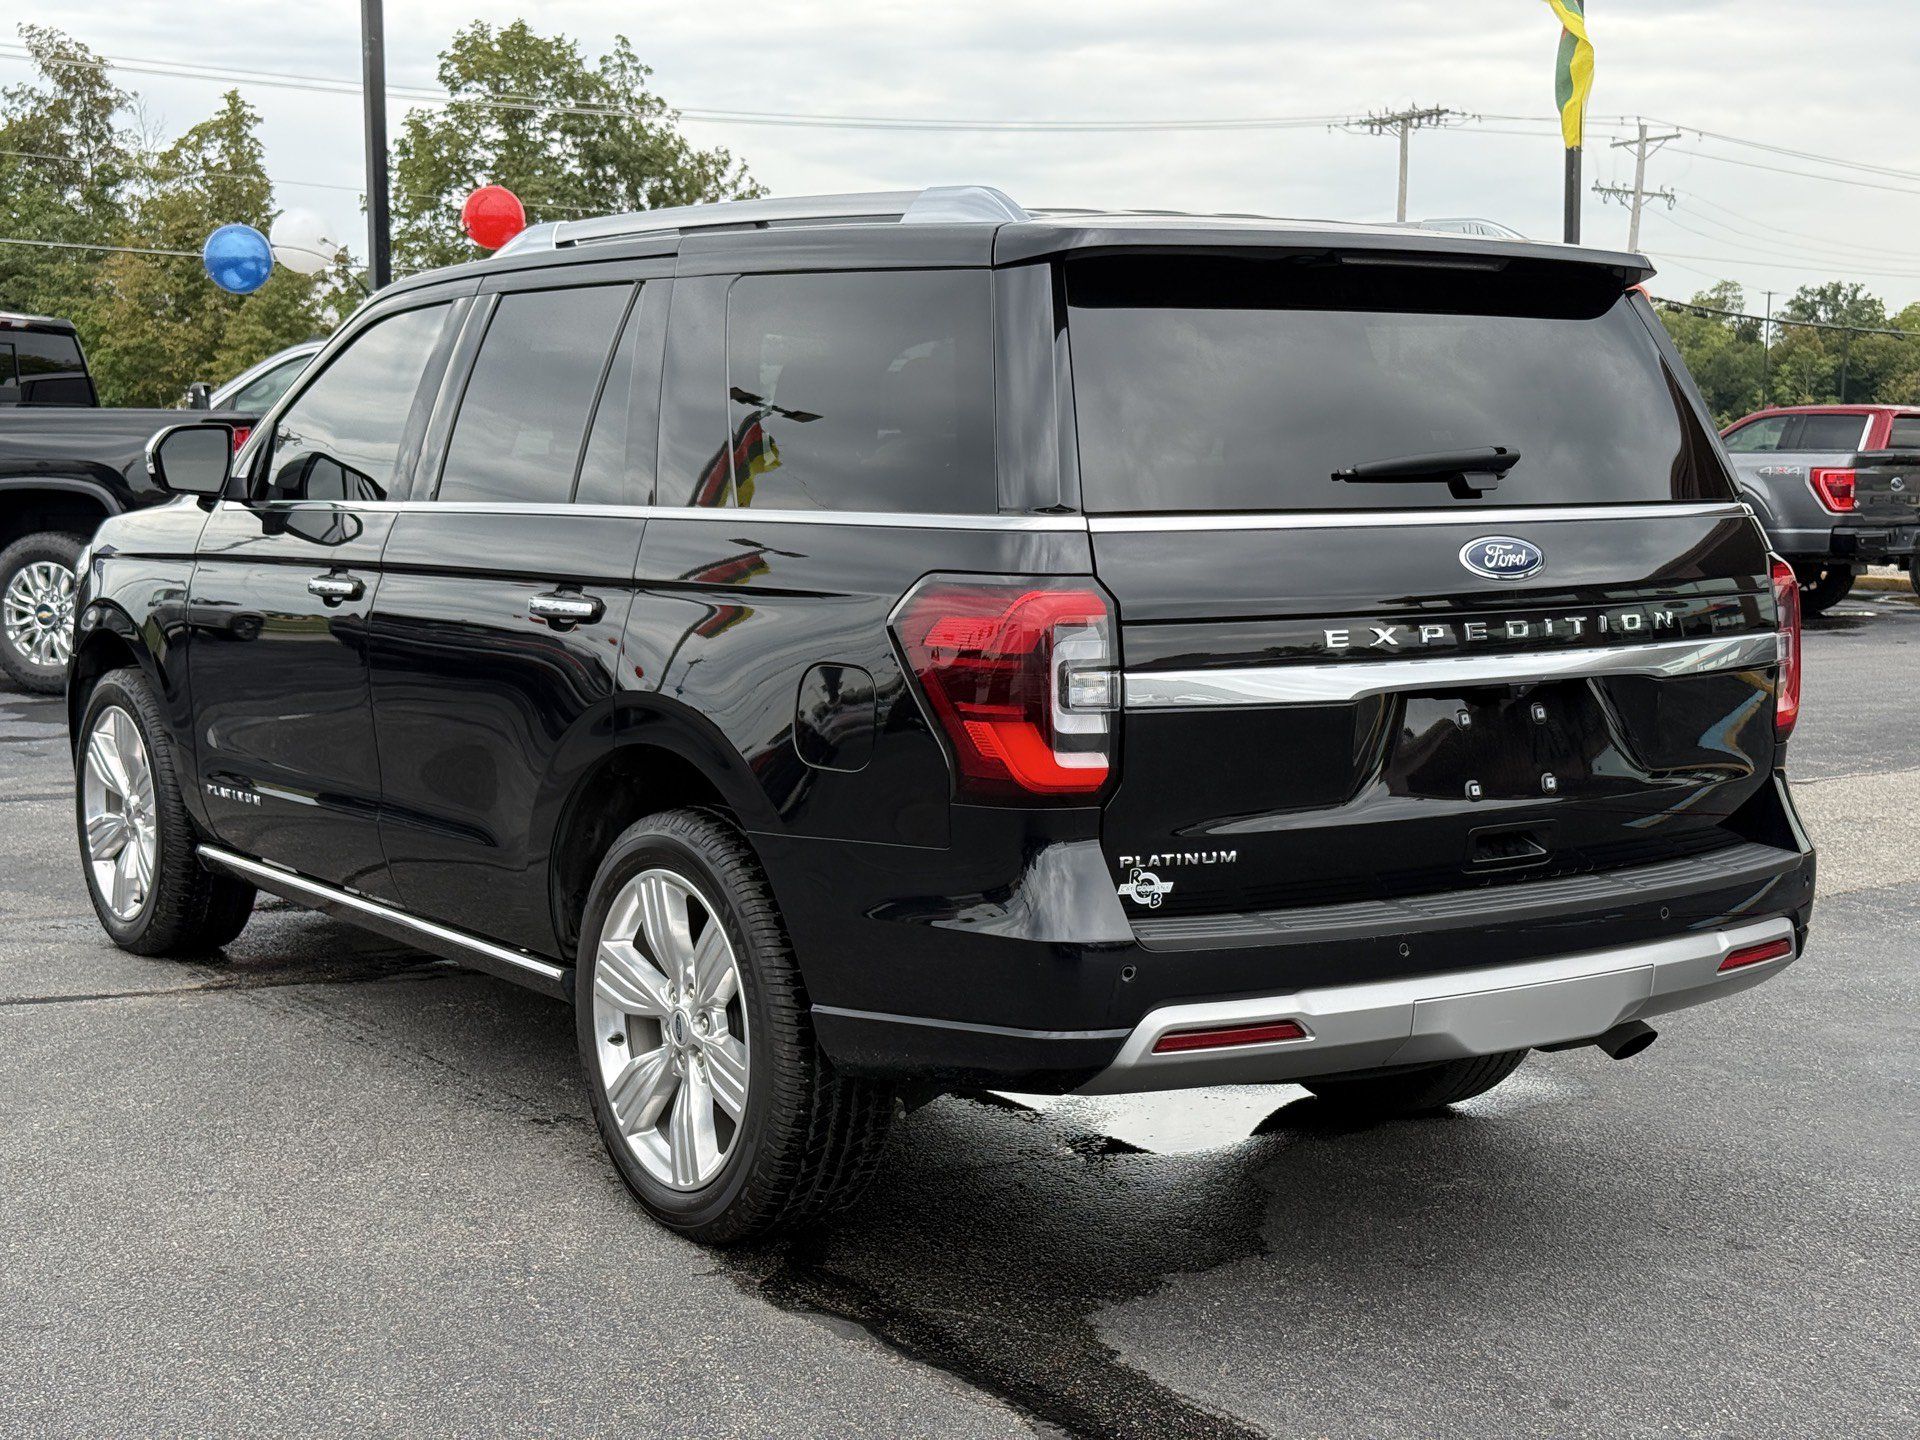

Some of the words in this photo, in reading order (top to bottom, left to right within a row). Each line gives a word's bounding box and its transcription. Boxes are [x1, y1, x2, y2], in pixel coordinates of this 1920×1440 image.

[1484, 544, 1528, 568] Ford
[1324, 611, 1674, 648] EXPEDITION
[207, 783, 262, 806] PLATINUM
[1119, 850, 1237, 868] PLATINUM
